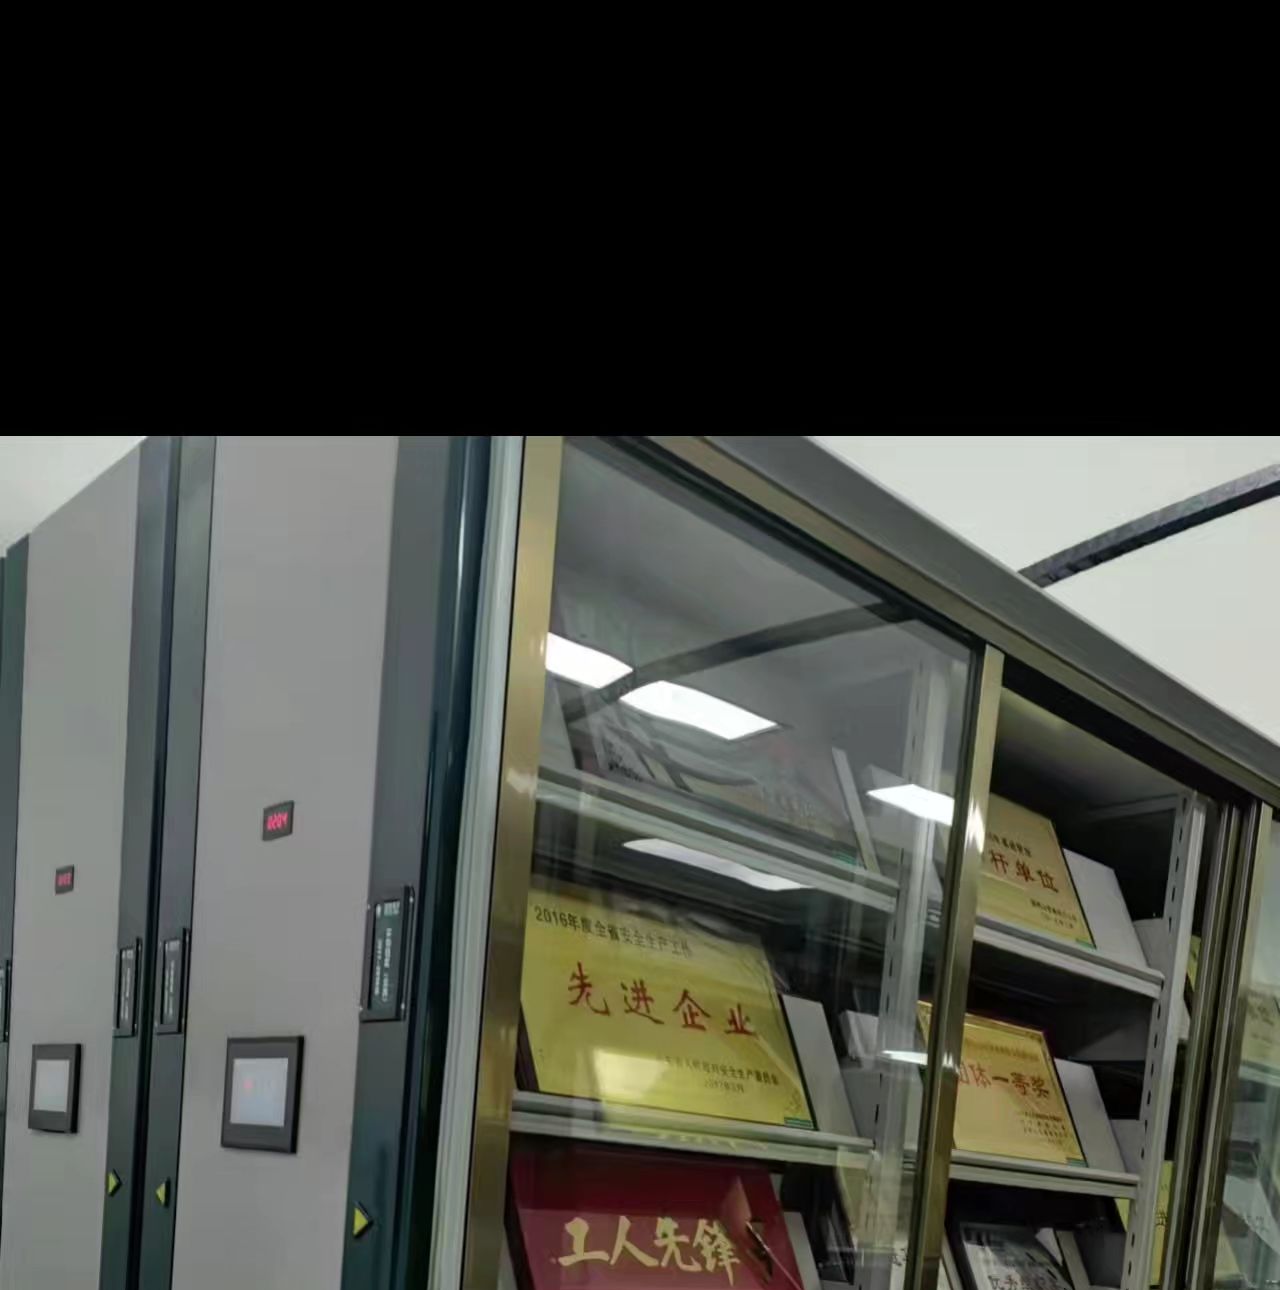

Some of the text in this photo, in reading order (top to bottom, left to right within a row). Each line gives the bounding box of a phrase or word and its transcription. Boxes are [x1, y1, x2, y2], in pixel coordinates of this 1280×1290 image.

[567, 960, 756, 1036] 先进企业
[557, 1215, 774, 1287] 工人先锋
